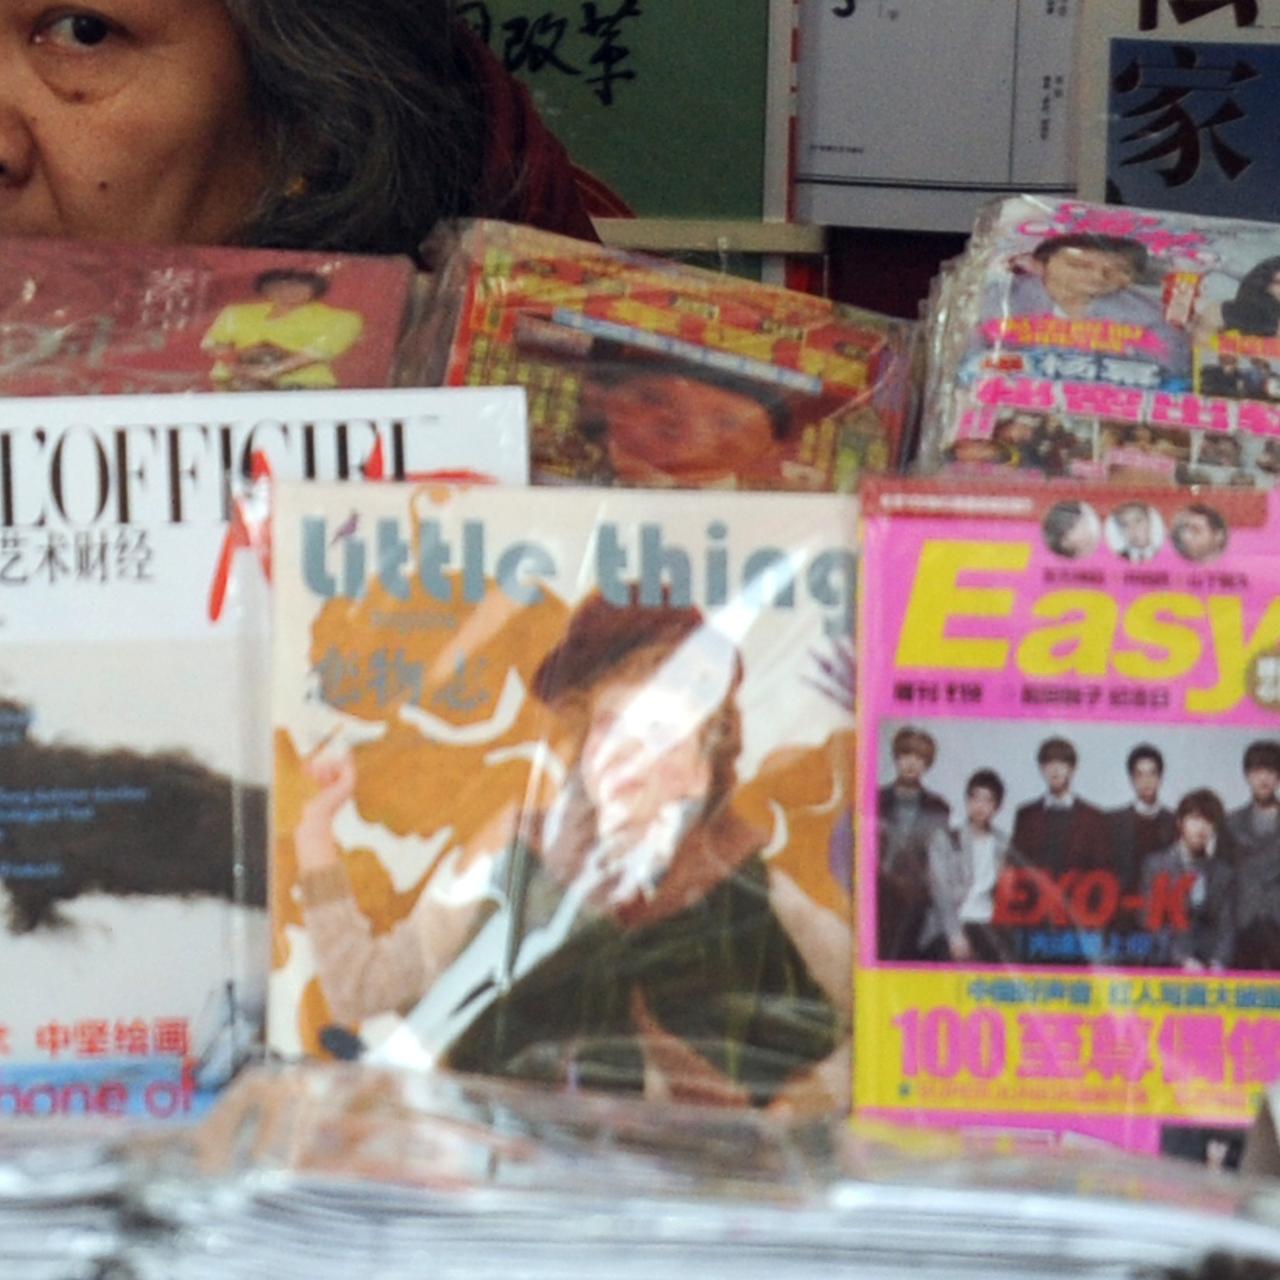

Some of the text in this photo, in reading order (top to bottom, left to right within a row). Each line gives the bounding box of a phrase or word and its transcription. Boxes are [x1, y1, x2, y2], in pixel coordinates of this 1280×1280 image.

[300, 512, 557, 605] little
[895, 538, 1280, 715] Easy
[990, 868, 1198, 932] EXO-K
